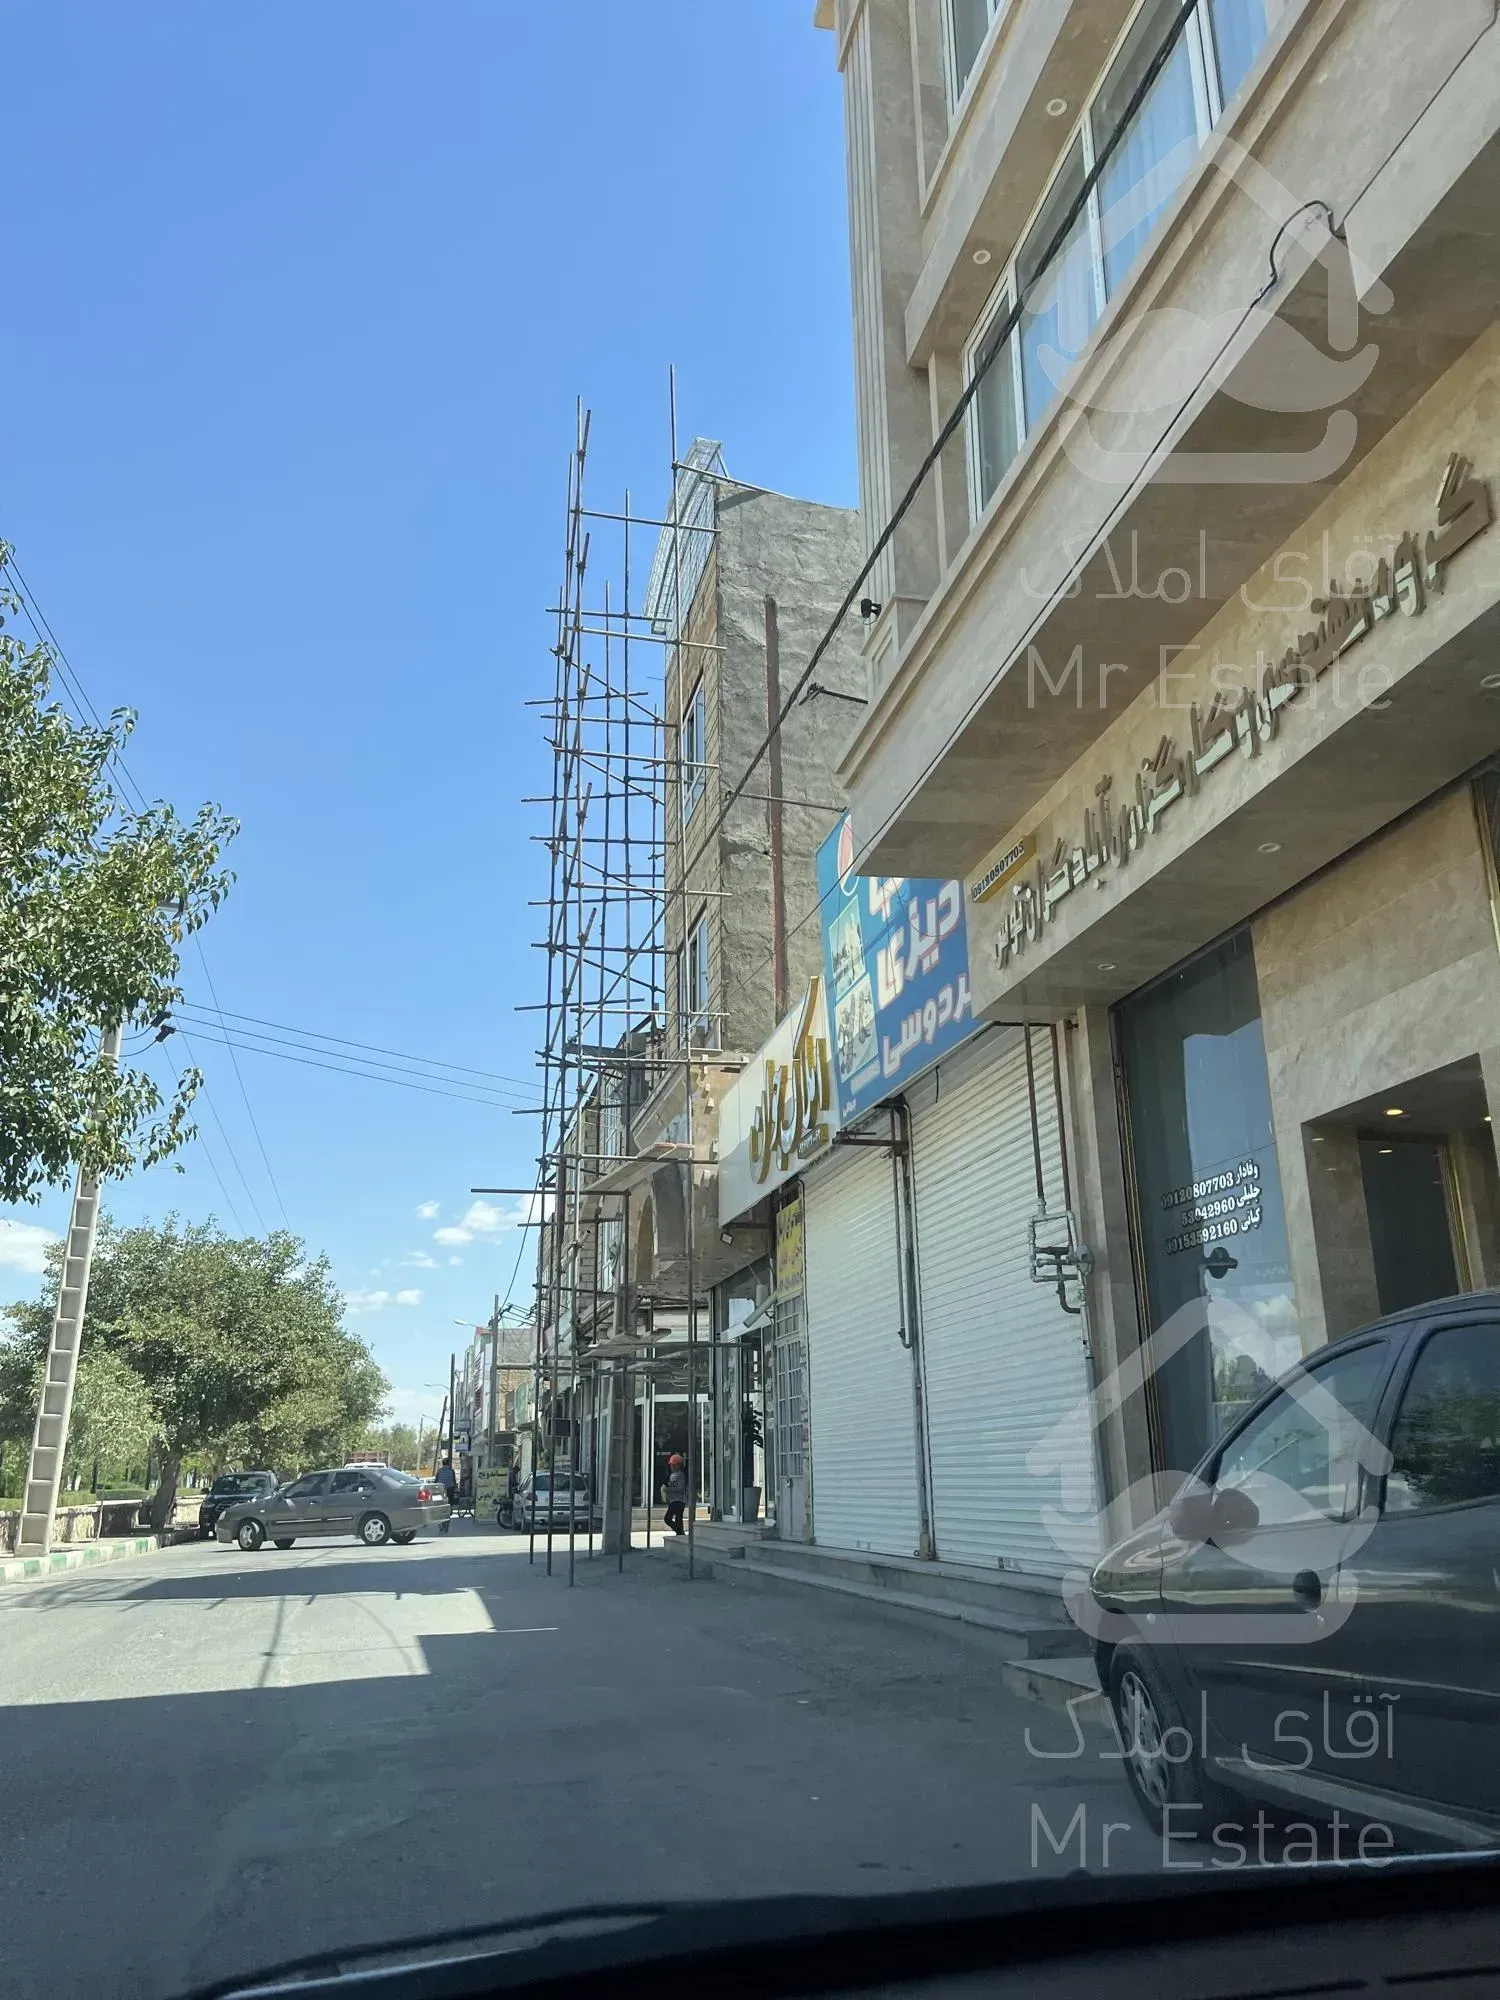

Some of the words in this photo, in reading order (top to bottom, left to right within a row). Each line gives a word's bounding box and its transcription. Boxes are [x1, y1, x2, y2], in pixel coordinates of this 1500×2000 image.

[877, 879, 960, 1011] دیزی
[882, 973, 972, 1079] ردوسی
[1235, 1159, 1260, 1185] وفادار
